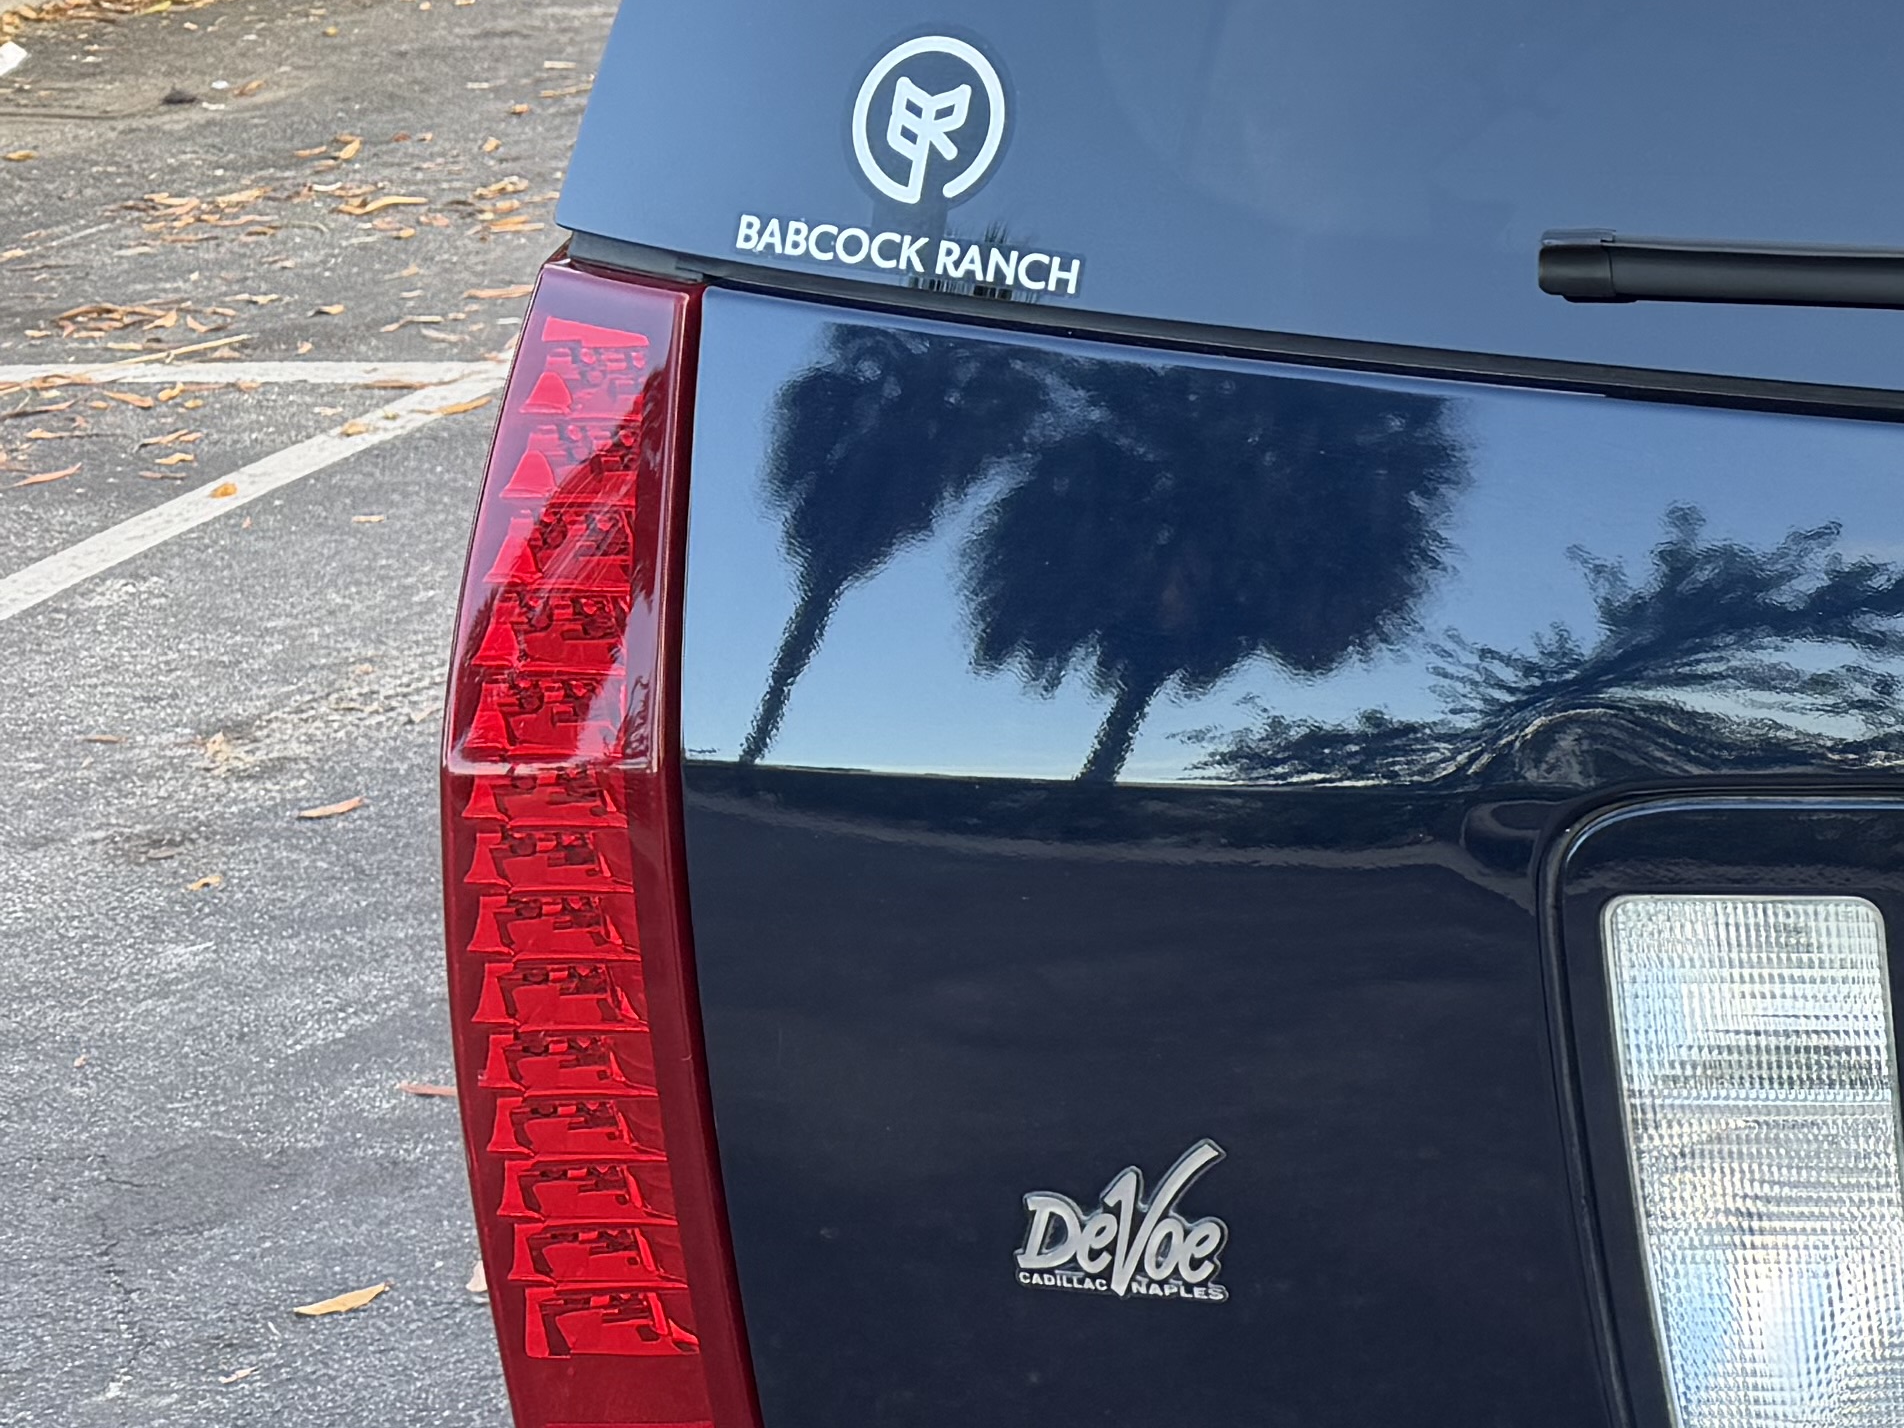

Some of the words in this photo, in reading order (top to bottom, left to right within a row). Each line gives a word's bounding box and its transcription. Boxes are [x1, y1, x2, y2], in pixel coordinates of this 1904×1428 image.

[735, 213, 930, 273] BABCOCK
[934, 239, 1082, 295] RANCH
[1016, 1140, 1226, 1299] DeVoe
[1018, 1271, 1109, 1292] CADILLAC
[1131, 1280, 1226, 1301] NAPLES
